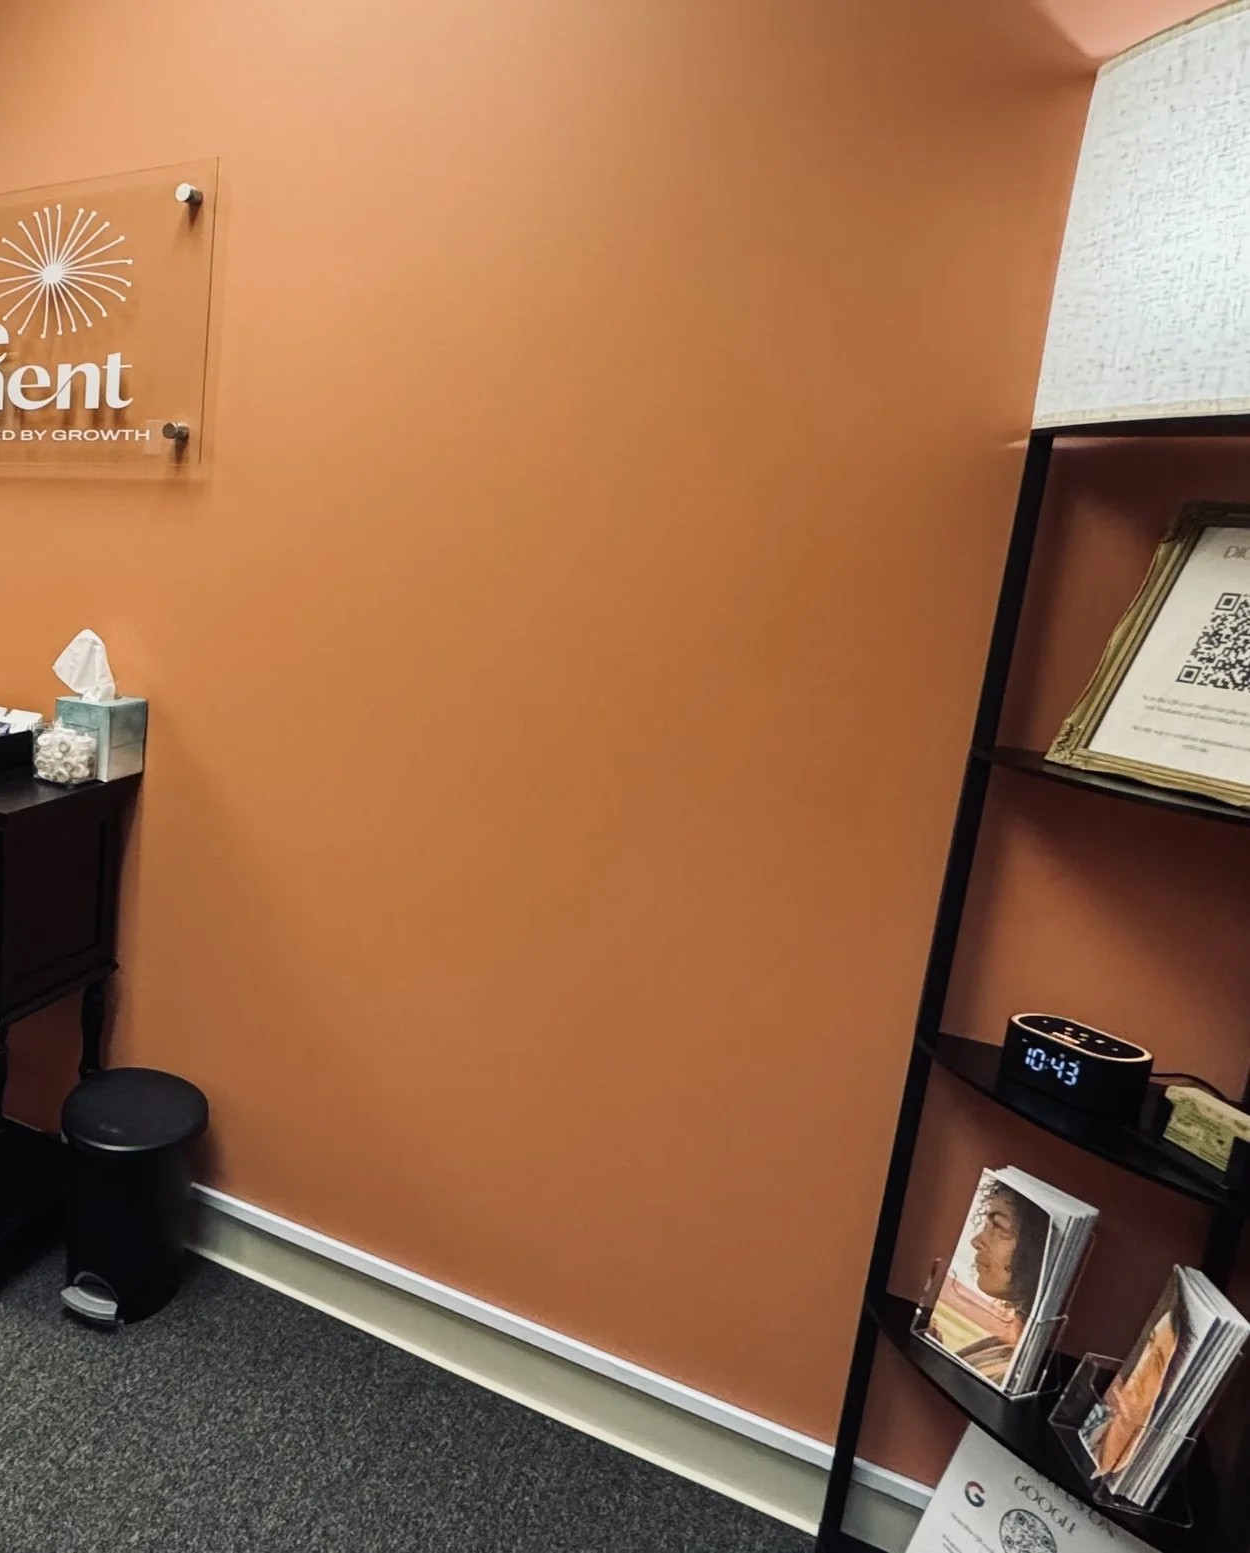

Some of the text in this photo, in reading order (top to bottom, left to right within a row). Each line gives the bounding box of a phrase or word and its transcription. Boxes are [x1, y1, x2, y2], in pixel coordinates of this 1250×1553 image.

[20, 429, 47, 441] BY
[51, 429, 150, 441] GROWTH
[1025, 1047, 1079, 1086] 10:43
